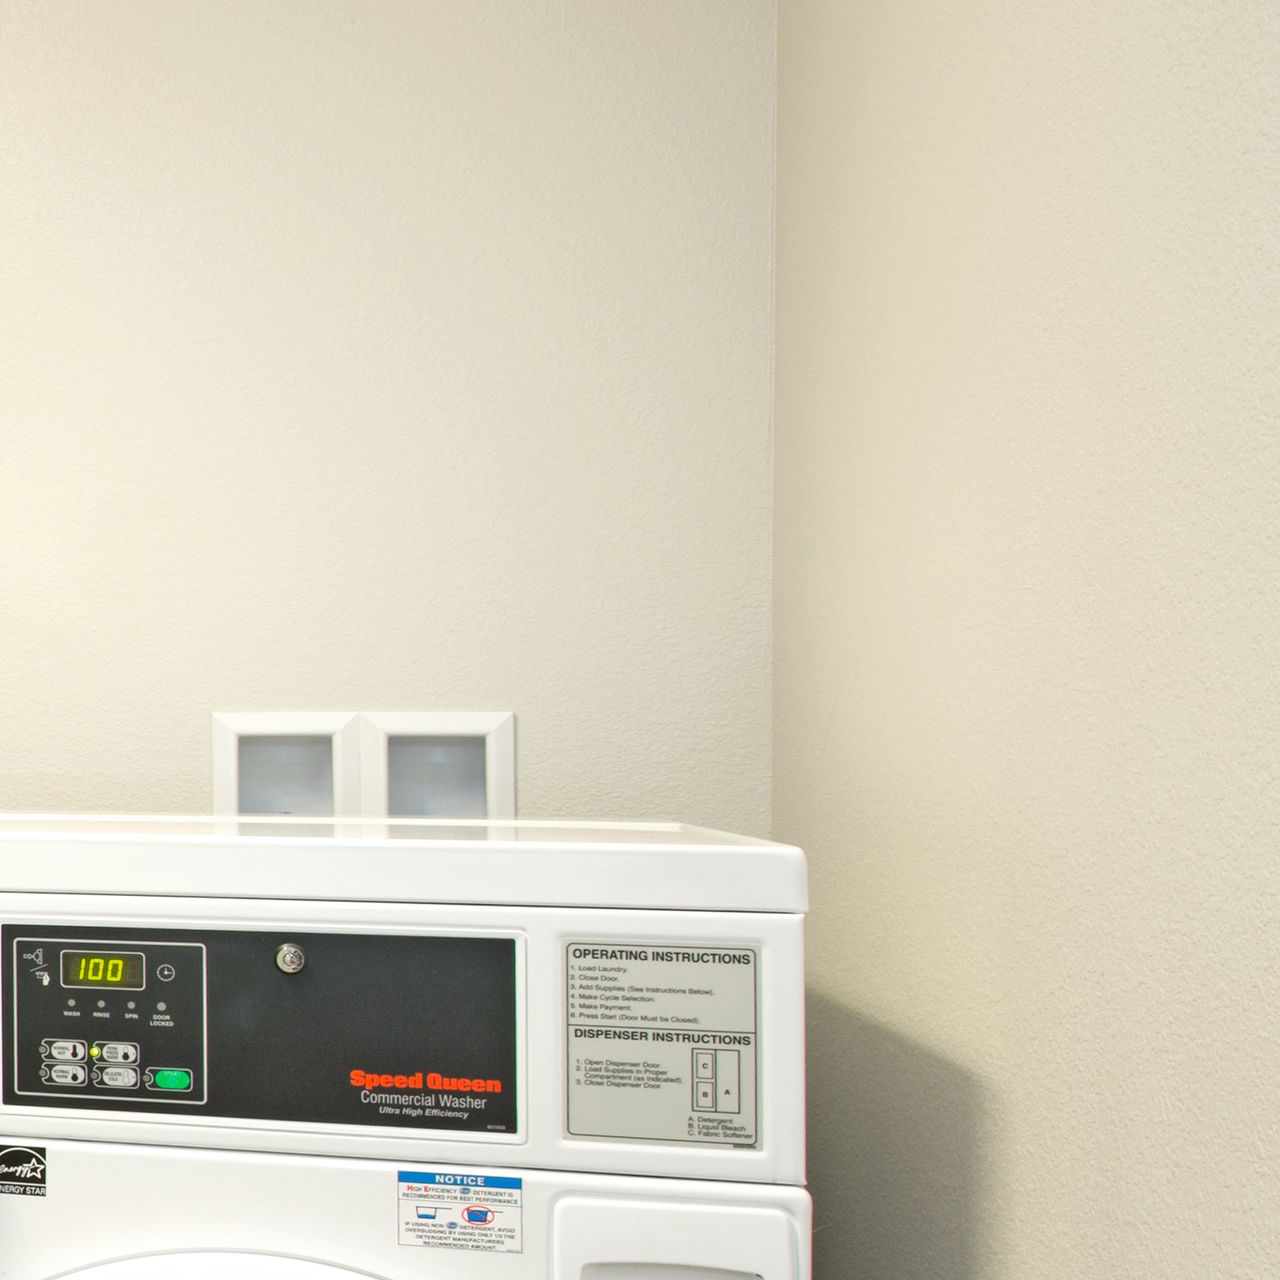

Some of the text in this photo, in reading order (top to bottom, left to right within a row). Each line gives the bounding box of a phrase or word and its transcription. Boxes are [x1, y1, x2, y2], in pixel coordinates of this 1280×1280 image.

[573, 949, 750, 965] OPERATING INSTRUCTIONS
[79, 958, 123, 981] 100
[598, 966, 628, 974] Laundry.
[595, 985, 625, 993] Supplies
[688, 988, 714, 996] Below).
[600, 994, 619, 1002] Cycle
[574, 1029, 751, 1045] DISPENSER INSTRUCTIONS
[584, 1059, 603, 1067] Open
[605, 1060, 640, 1068] Dispenser
[604, 1067, 634, 1075] Supplies
[350, 1070, 501, 1093] Speed Queen
[584, 1073, 632, 1082] Compartment
[606, 1081, 642, 1089] Dispenser
[361, 1090, 487, 1109] Commercial Washer
[379, 1106, 469, 1119] Ultra High Efficiency
[697, 1116, 733, 1125] Detergent
[435, 1175, 485, 1185] NOTICE
[26, 1187, 46, 1195] STAR
